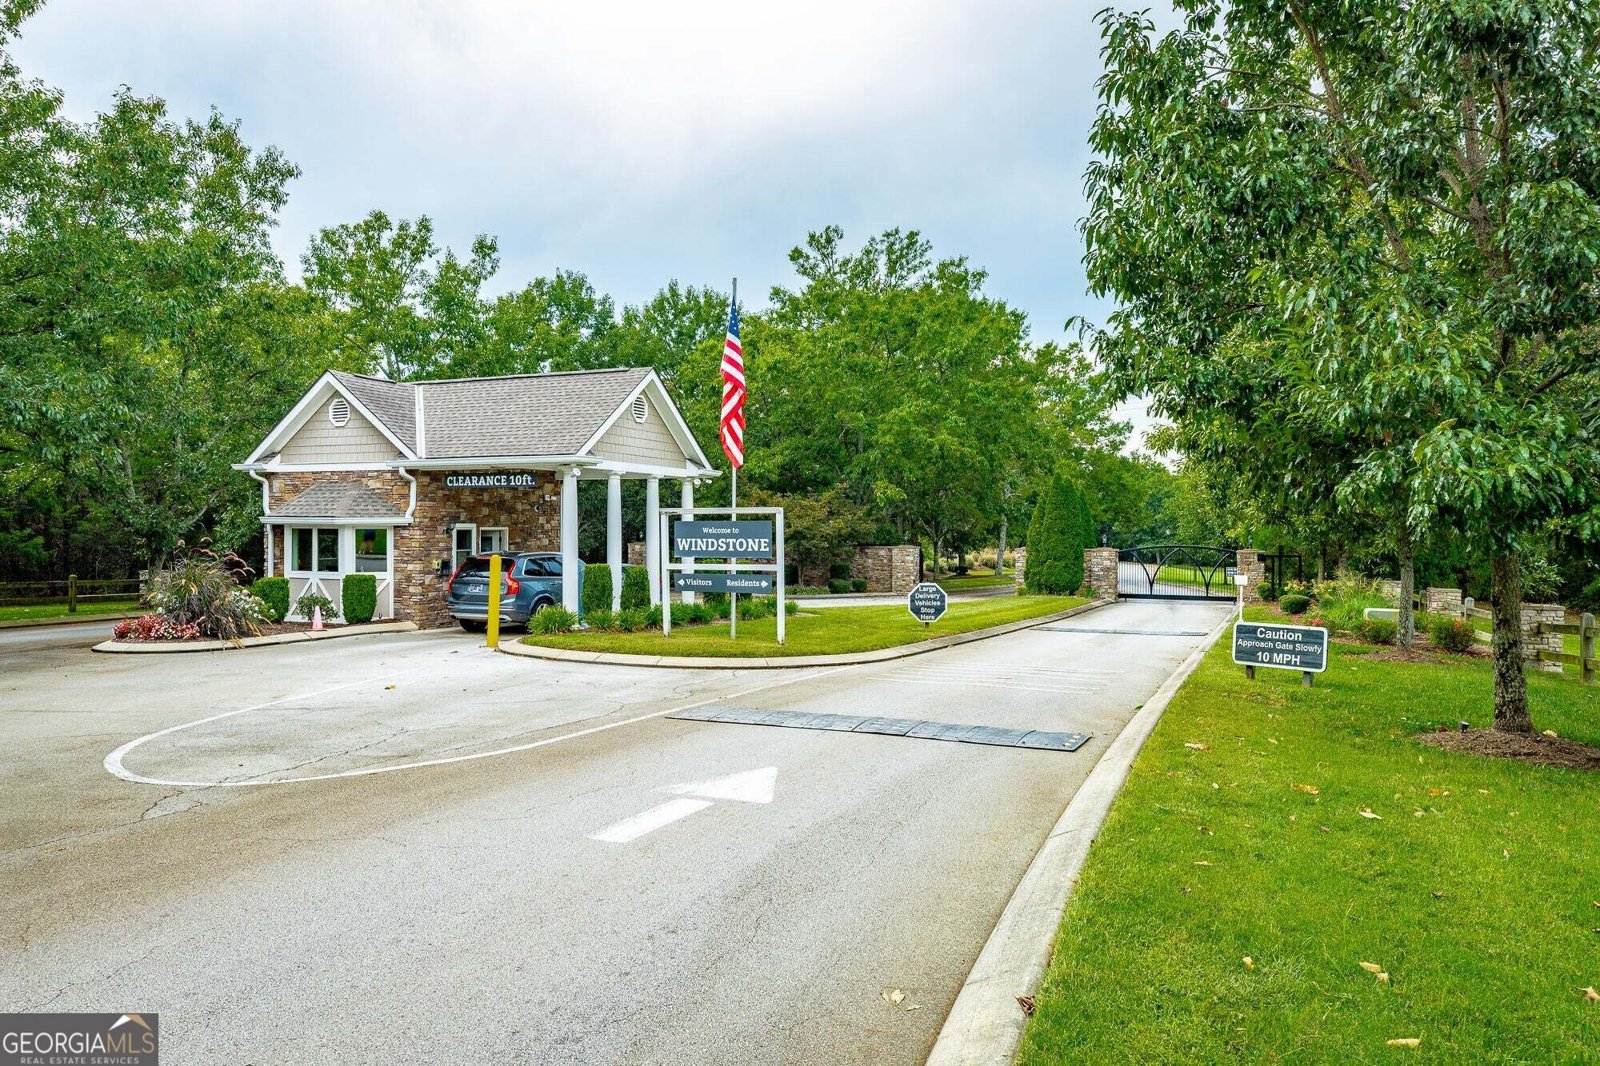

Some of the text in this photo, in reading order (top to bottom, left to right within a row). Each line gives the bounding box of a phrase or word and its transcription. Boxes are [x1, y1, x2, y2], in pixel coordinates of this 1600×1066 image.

[446, 474, 535, 486] CLEARANCE 10ft.
[677, 538, 770, 552] WINDSTONE
[1256, 628, 1302, 641] Caution
[1238, 638, 1322, 654] Approach Gate Slowly
[1257, 652, 1300, 666] 10 MPH
